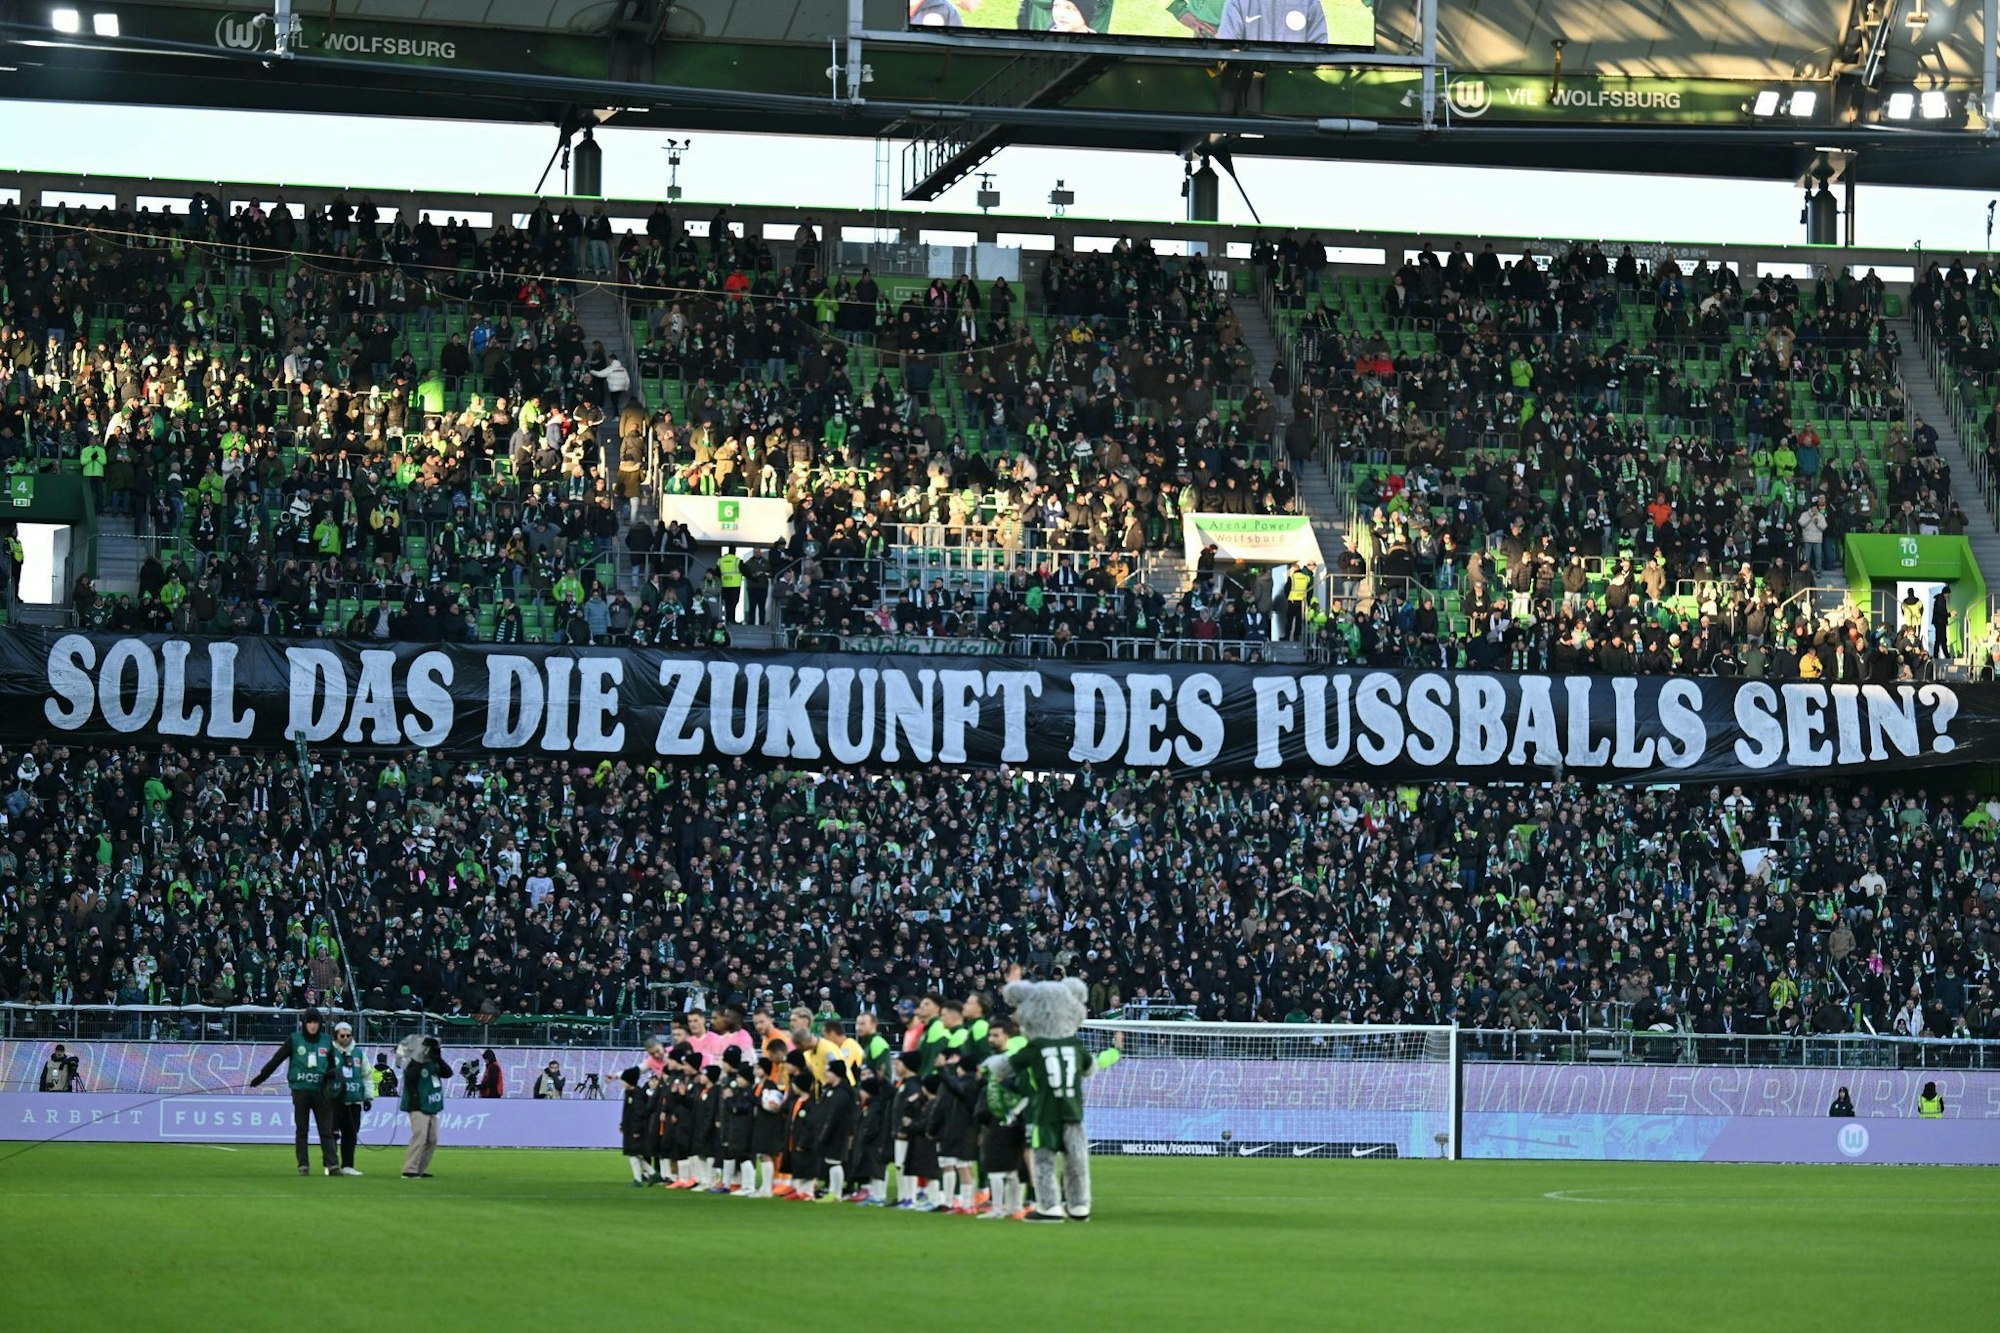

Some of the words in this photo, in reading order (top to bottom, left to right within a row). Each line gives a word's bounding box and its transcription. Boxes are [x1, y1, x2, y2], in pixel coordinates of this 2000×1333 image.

[323, 33, 456, 59] WOLFSBURG
[1506, 88, 1538, 106] VfL
[1550, 88, 1681, 109] WOLFSBURG
[17, 481, 28, 493] 4
[724, 505, 734, 518] 6
[1209, 520, 1247, 530] Arena
[1254, 520, 1292, 531] Power
[1216, 533, 1286, 544] Wolfsburg
[1901, 543, 1918, 555] 10
[44, 634, 256, 739] SOLL
[284, 647, 454, 748] DAS
[481, 654, 626, 753] DIE
[655, 660, 1043, 765] ZUKUNFT
[1067, 671, 1225, 768] DES
[1252, 674, 1707, 769] FUSSBALLS
[1733, 681, 1960, 769] SEIN?
[297, 1072, 322, 1083] HOS
[21, 1108, 143, 1125] ARBEIT
[1122, 1143, 1218, 1156] NIKE.COM/FOOTBALL
